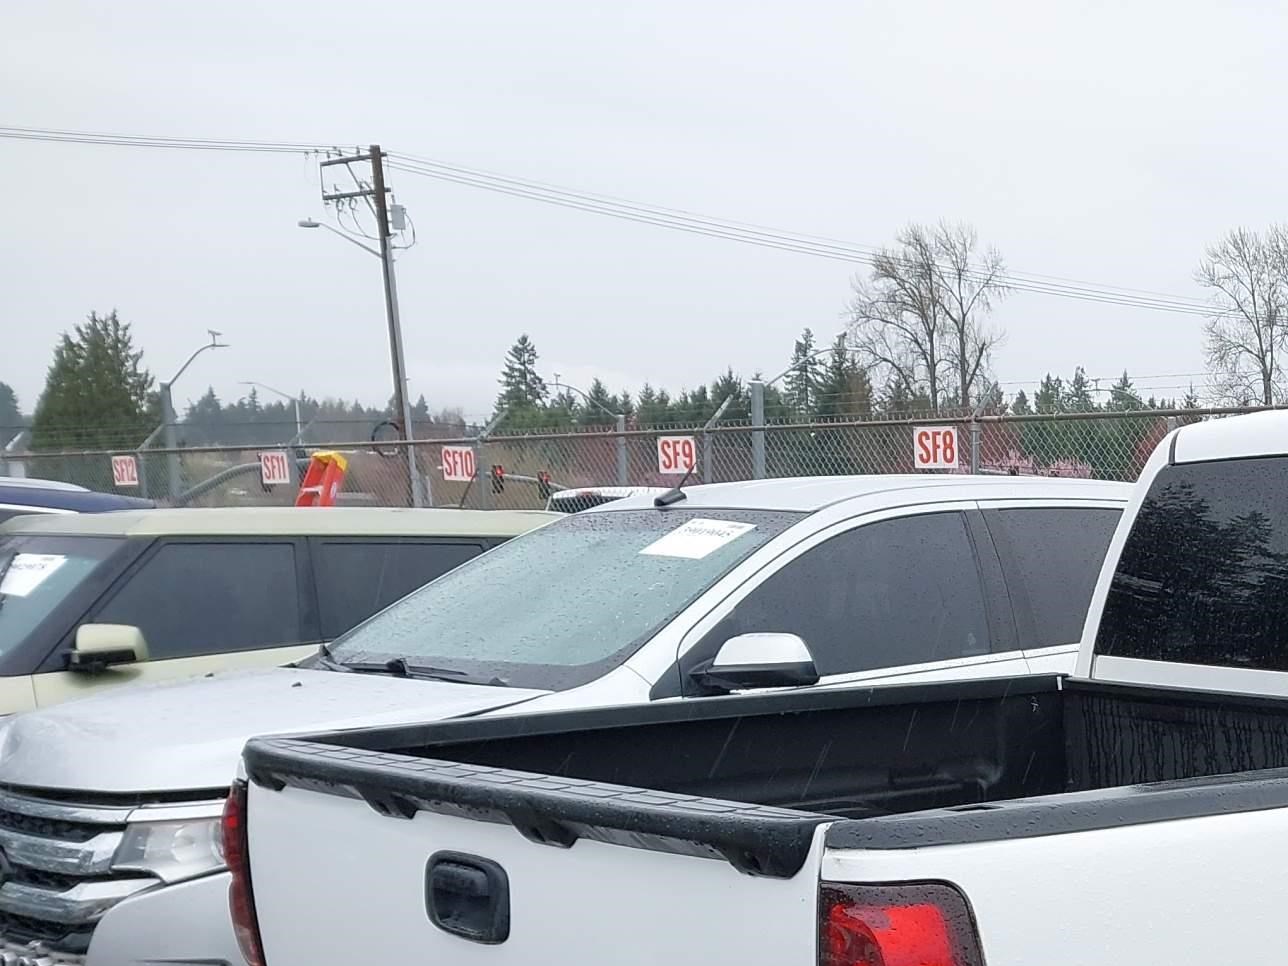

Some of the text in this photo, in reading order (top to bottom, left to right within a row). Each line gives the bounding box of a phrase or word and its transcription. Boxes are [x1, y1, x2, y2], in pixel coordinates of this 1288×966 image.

[660, 439, 693, 470] SF9
[917, 430, 955, 464] SF8
[113, 458, 137, 483] SF12
[263, 454, 288, 480] SF11
[442, 448, 475, 478] SF10
